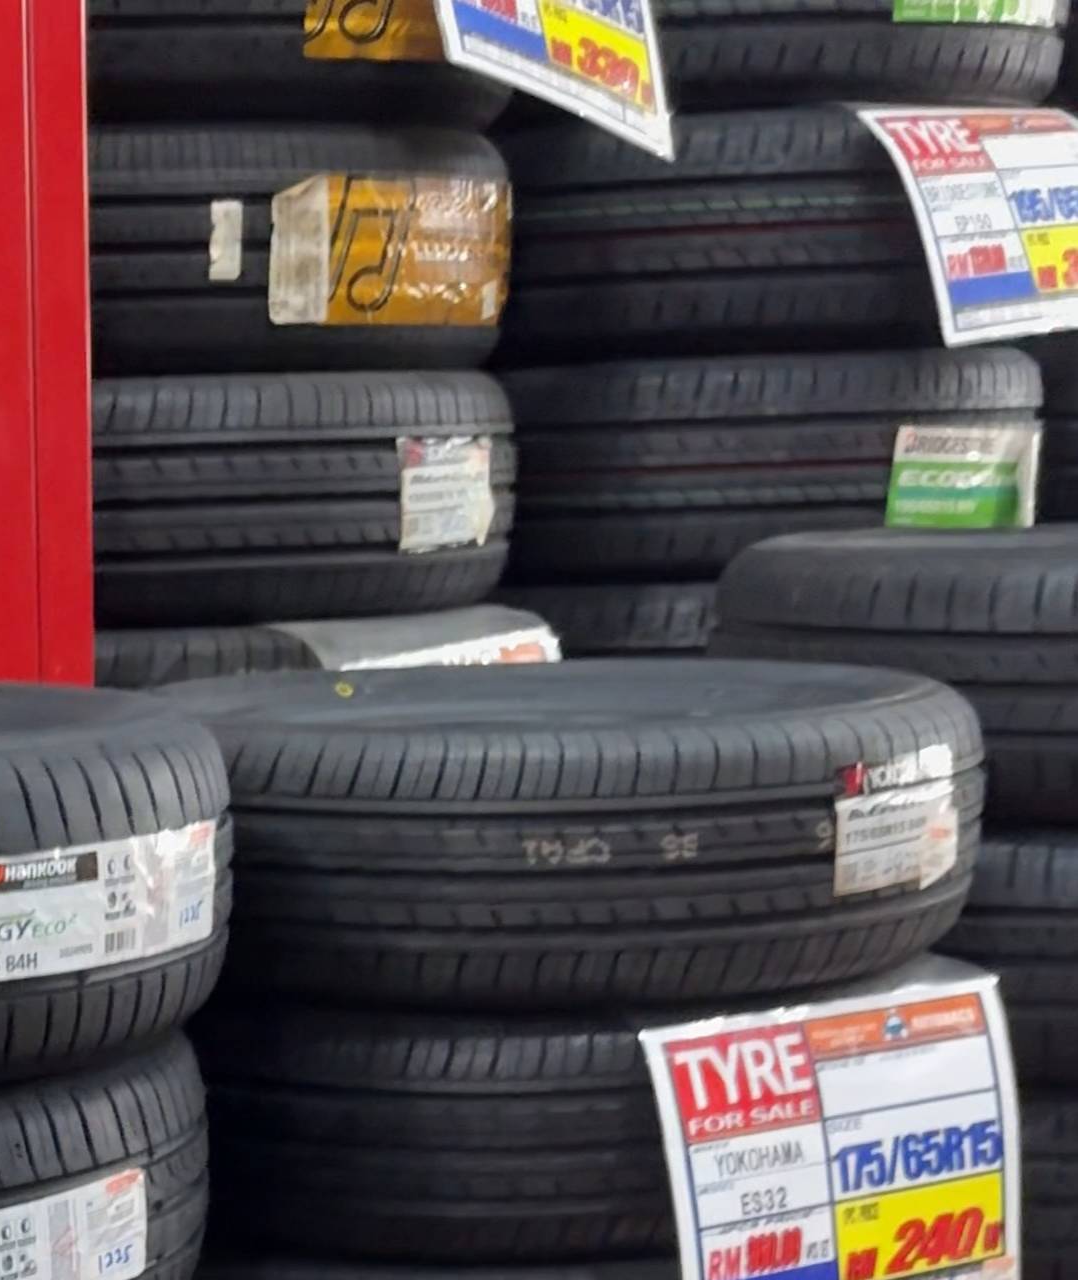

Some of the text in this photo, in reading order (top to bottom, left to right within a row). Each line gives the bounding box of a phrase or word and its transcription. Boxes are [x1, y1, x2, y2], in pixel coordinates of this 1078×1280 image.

[886, 117, 980, 154] TYRE
[913, 155, 986, 172] FOR SALE
[5, 951, 39, 973] 84H
[674, 1031, 813, 1111] TYRE
[688, 1098, 815, 1136] FOR SALE
[714, 1140, 804, 1177] YOKOHAMA
[830, 1119, 1004, 1193] 175/65R15
[740, 1186, 787, 1216] ES32
[884, 1206, 984, 1275] 240
